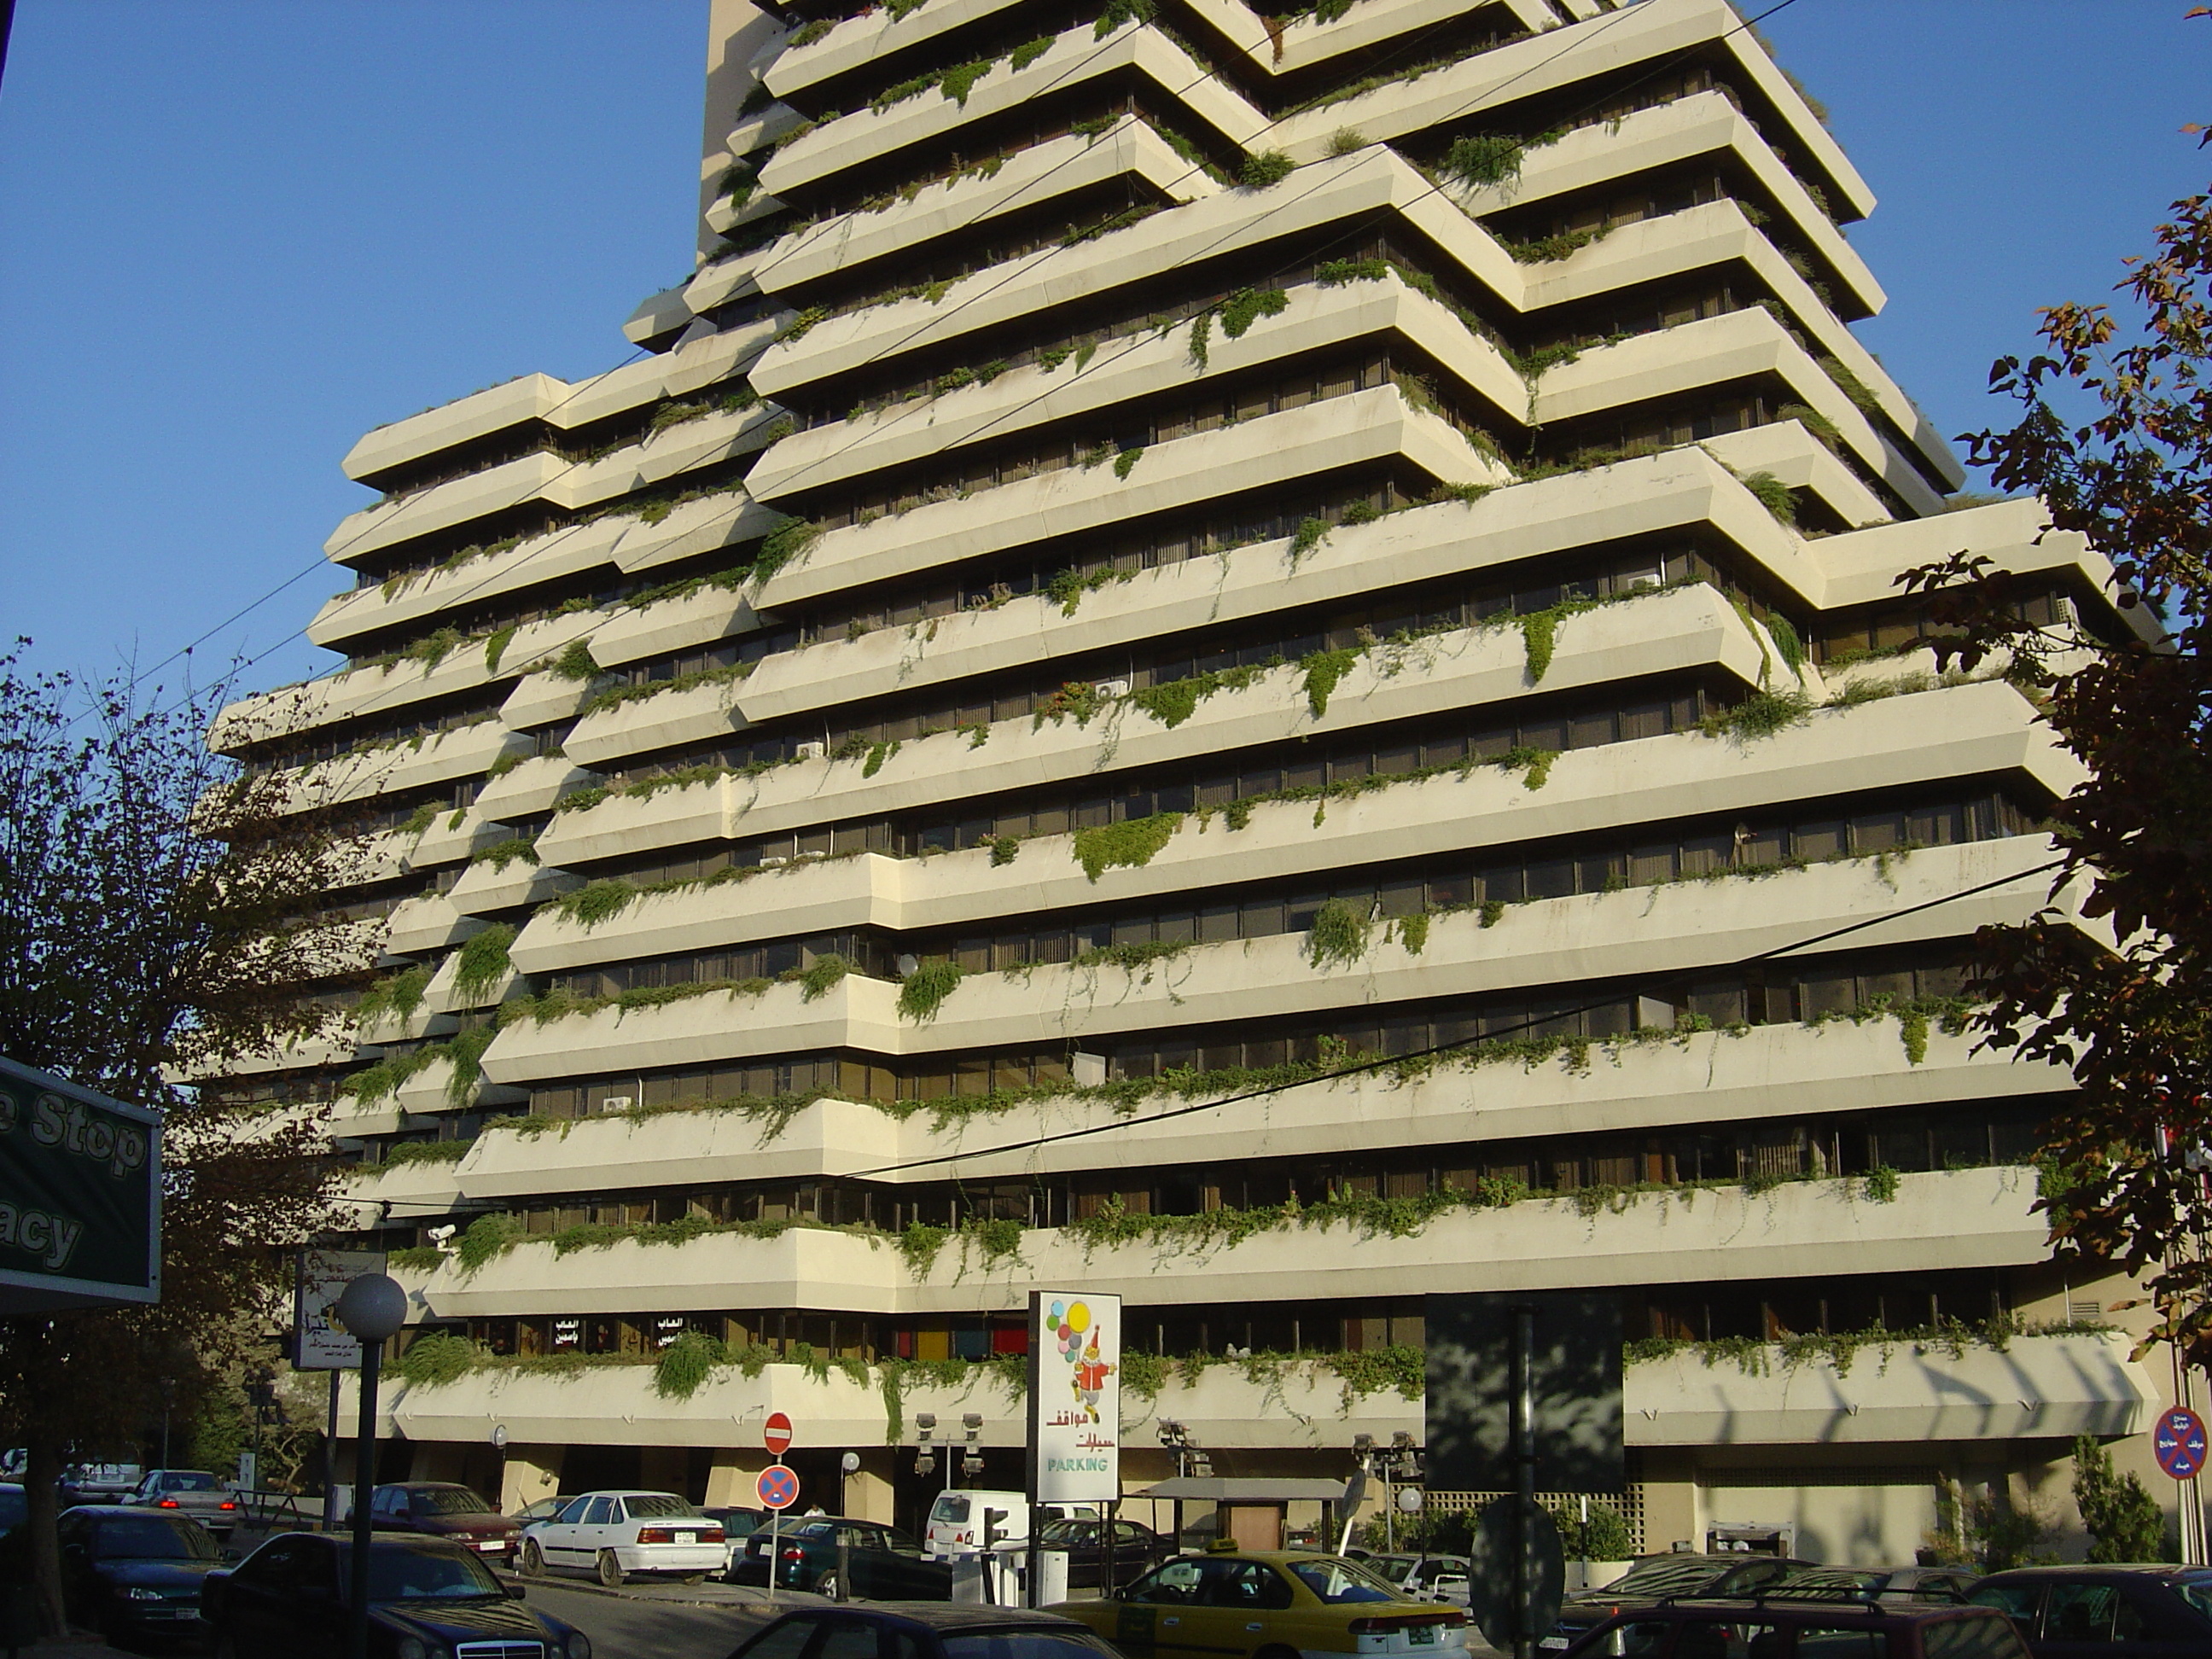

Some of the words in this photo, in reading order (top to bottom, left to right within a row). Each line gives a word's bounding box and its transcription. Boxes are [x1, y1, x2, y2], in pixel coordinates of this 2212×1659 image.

[32, 1092, 146, 1178] Stop
[1046, 1410, 1088, 1428] مواقف
[1076, 1433, 1115, 1452] سيارات
[1048, 1458, 1108, 1472] PARKING
